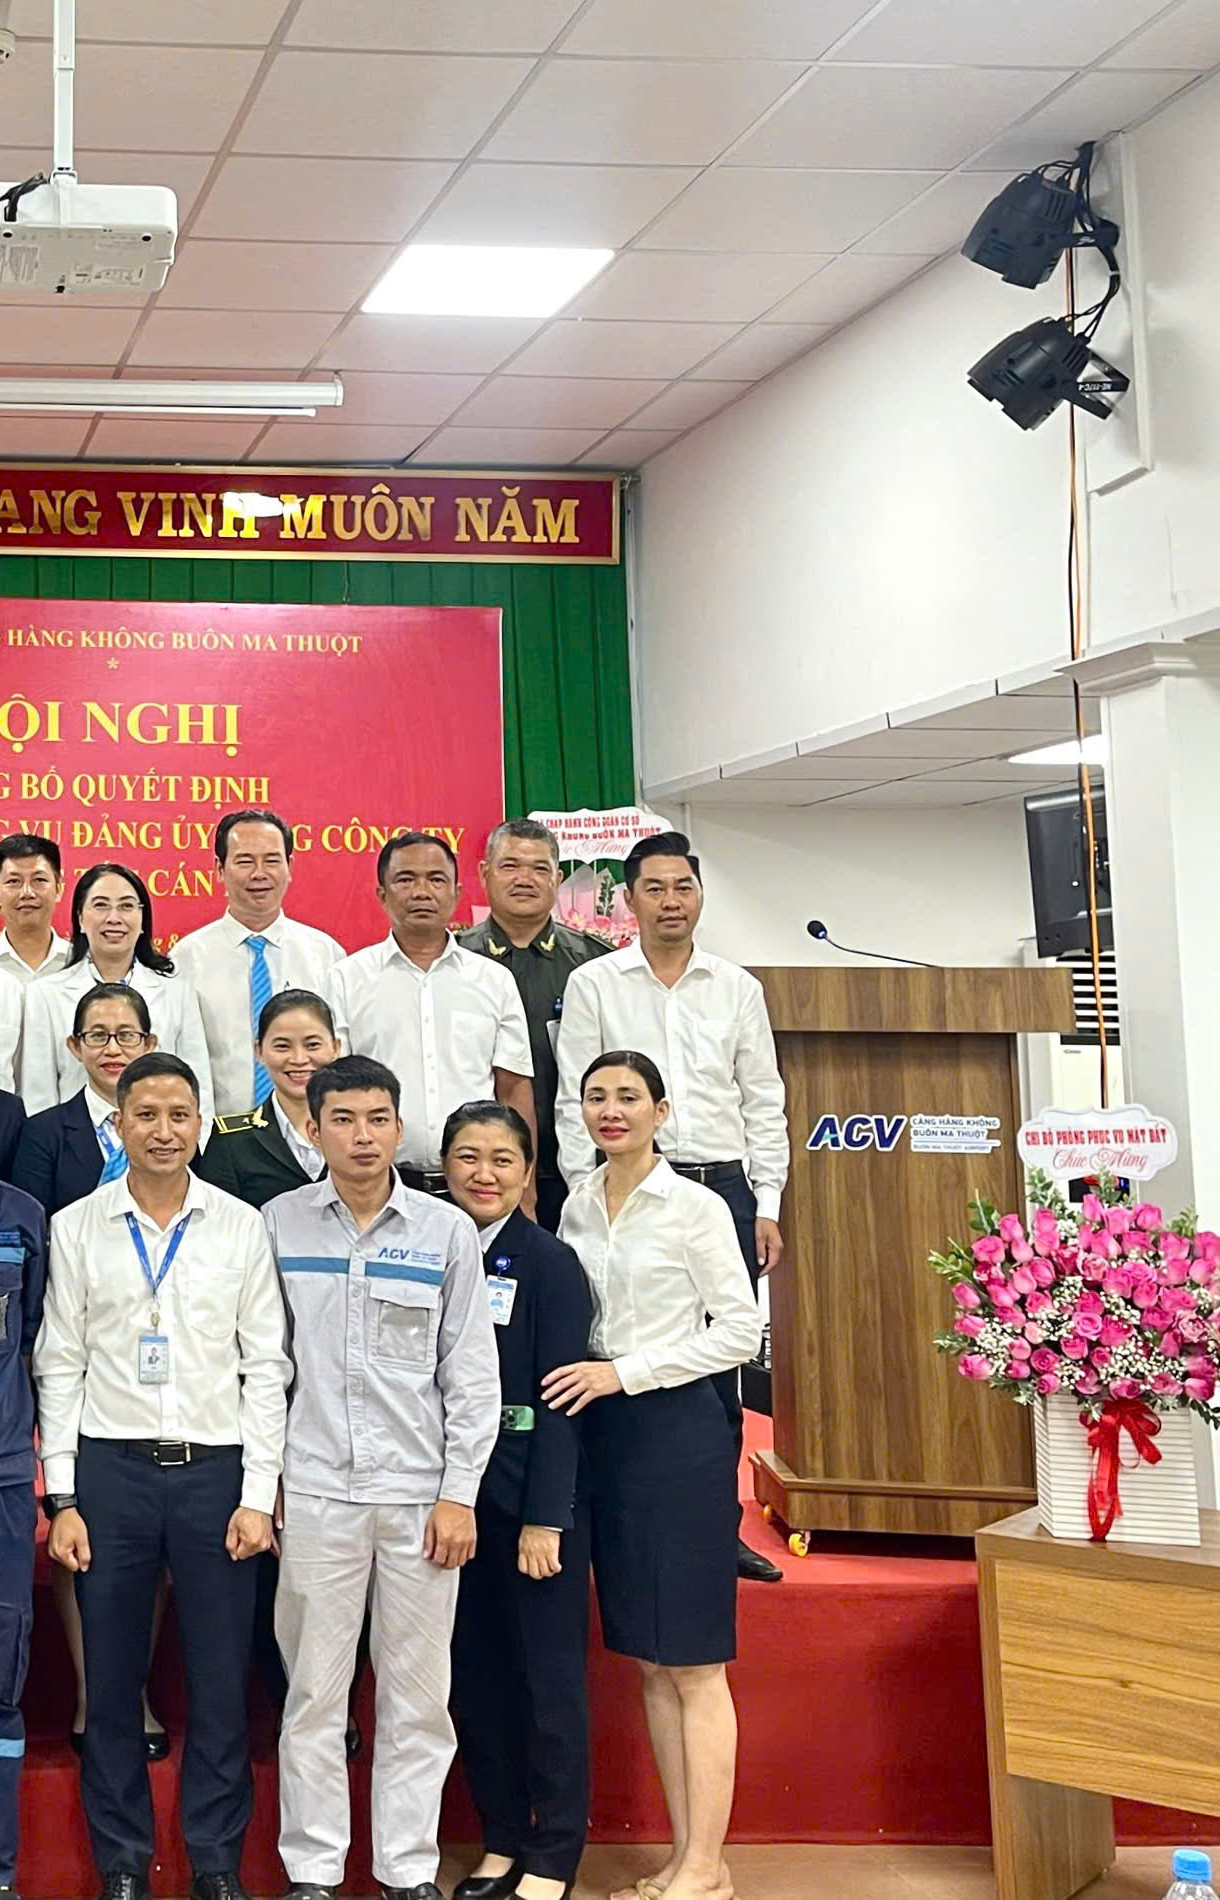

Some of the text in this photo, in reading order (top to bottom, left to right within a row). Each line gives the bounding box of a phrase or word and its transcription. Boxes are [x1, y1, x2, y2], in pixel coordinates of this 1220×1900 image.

[116, 491, 261, 539] VINH
[279, 482, 435, 541] MUÔN
[454, 485, 580, 543] NĂM
[7, 624, 74, 648] HÀNG
[79, 626, 165, 649] KHÔNG
[171, 628, 235, 650] BUÔN
[242, 633, 278, 651] MA
[282, 632, 363, 657] THUỘT
[82, 702, 243, 757] NGHỊ
[20, 765, 64, 801] BỐ
[72, 767, 182, 807] QUYẾT
[189, 776, 270, 810] ĐỊNH
[72, 813, 162, 849] ĐẢNG
[172, 815, 215, 849] ỦY
[148, 861, 214, 897] CÁN
[809, 1117, 905, 1148] ACV
[1025, 1131, 1040, 1146] CHI
[1056, 1127, 1085, 1145] PHÒNG
[378, 1247, 410, 1260] ACV
